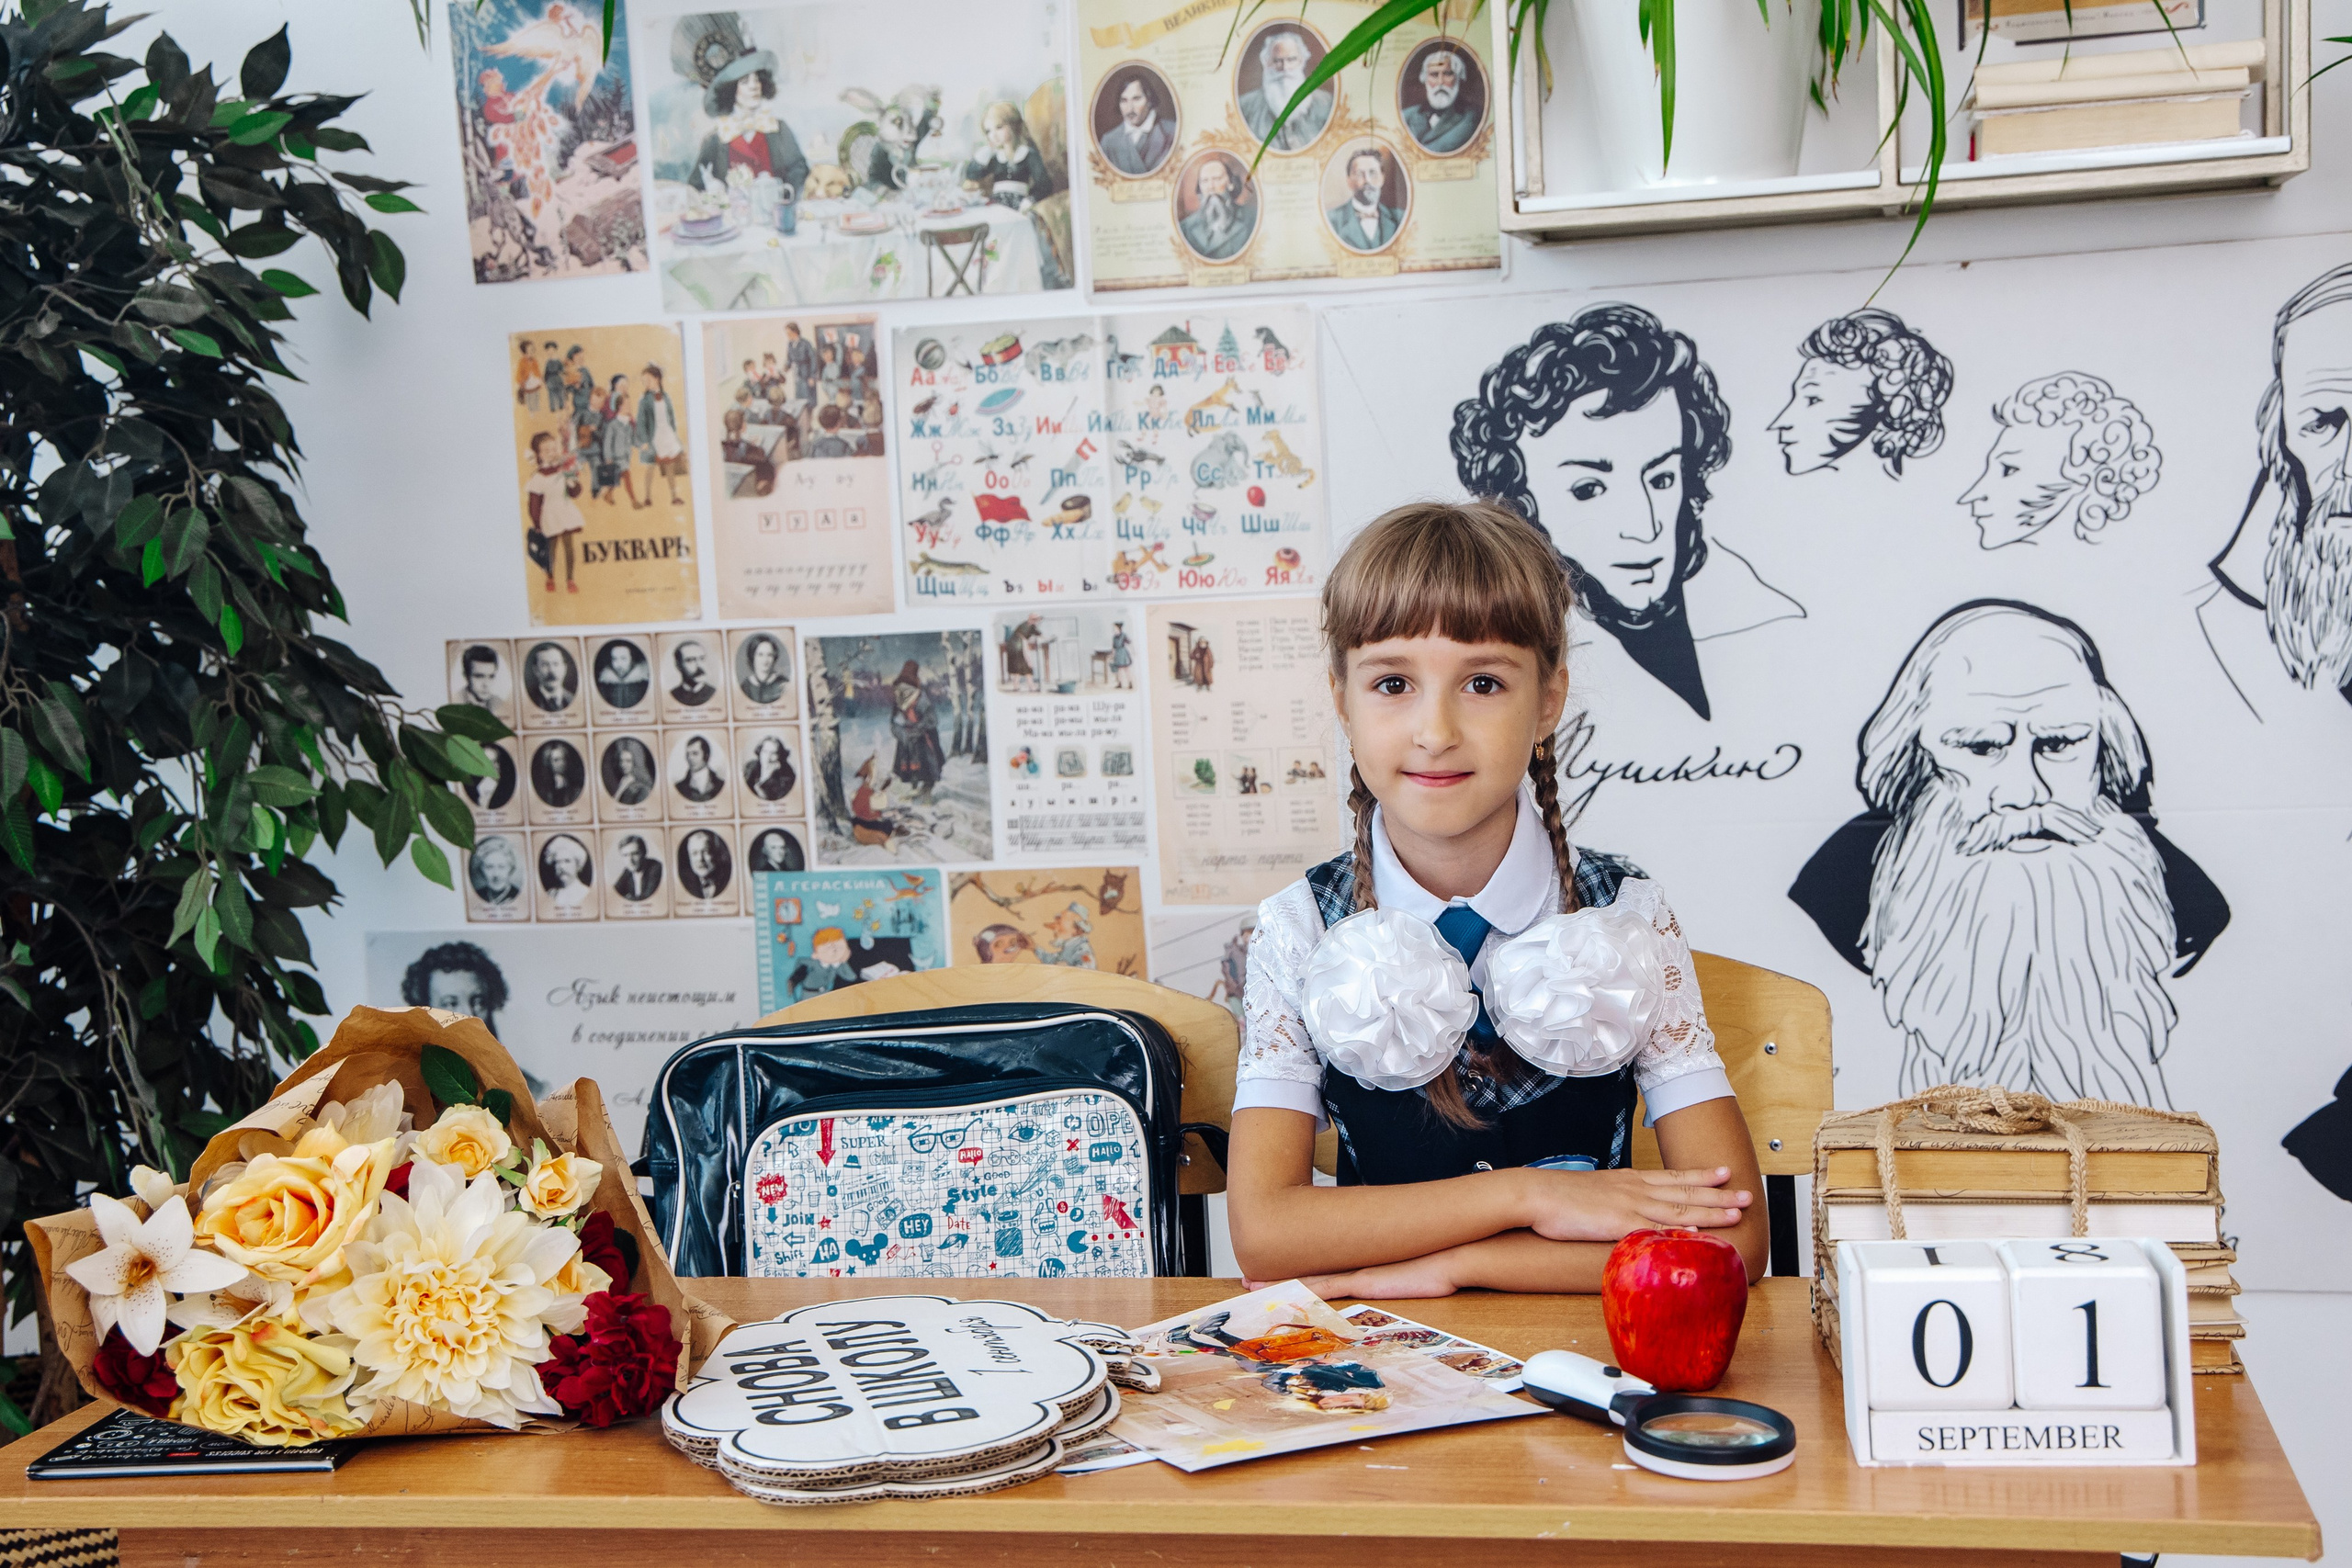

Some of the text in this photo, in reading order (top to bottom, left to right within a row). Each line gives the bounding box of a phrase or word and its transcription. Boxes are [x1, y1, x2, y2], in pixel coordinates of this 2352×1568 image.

[910, 367, 935, 386] Аа
[975, 366, 998, 384] Бб
[1040, 363, 1066, 381] Вв
[1154, 357, 1180, 378] Дд
[1215, 355, 1237, 373] Ее
[910, 419, 942, 438] Жж
[992, 417, 1013, 436] Зз
[1036, 417, 1062, 434] Ии
[1138, 412, 1159, 431] Кк
[1193, 410, 1216, 428] Лл
[1247, 407, 1275, 425] Мм
[912, 473, 937, 491] Нн
[985, 470, 1009, 489] Оо
[1051, 468, 1076, 489] Пп
[1125, 466, 1151, 491] Рр
[1198, 464, 1221, 481] Сс
[1253, 460, 1275, 479] Тт
[915, 524, 939, 548] Уу
[975, 522, 1010, 547] Фф
[1051, 523, 1075, 540] Хх
[1116, 519, 1144, 541] Цц
[1182, 516, 1206, 536] Чч
[1241, 514, 1280, 534] Шш
[582, 536, 690, 563] БУКВАРЬ
[916, 577, 956, 597] Щщ
[1117, 572, 1141, 591] Ээ
[1179, 570, 1216, 589] Юю
[1264, 566, 1291, 586] Яя
[791, 879, 886, 892] ГЕРАСКИНА
[546, 977, 736, 1011] Язык неистощим
[588, 1030, 690, 1050] соединении
[841, 1135, 888, 1149] SUPER
[790, 1159, 815, 1174] mp3
[984, 1170, 1011, 1181] GOOD
[761, 1184, 786, 1197] NEW
[947, 1184, 998, 1203] Style
[866, 1196, 889, 1213] GOOD
[904, 1219, 929, 1235] HEY
[775, 1249, 805, 1266] Shift
[819, 1242, 839, 1261] HA
[2049, 1242, 2110, 1263] 8
[944, 1314, 1023, 1365] сентября
[722, 1339, 854, 1426] СНОВА
[815, 1320, 981, 1430] В ШКОЛУ
[1918, 1424, 2126, 1451] SEPTEMBER
[205, 1449, 254, 1457] SUCCESS
[254, 1448, 275, 1456] FOR
